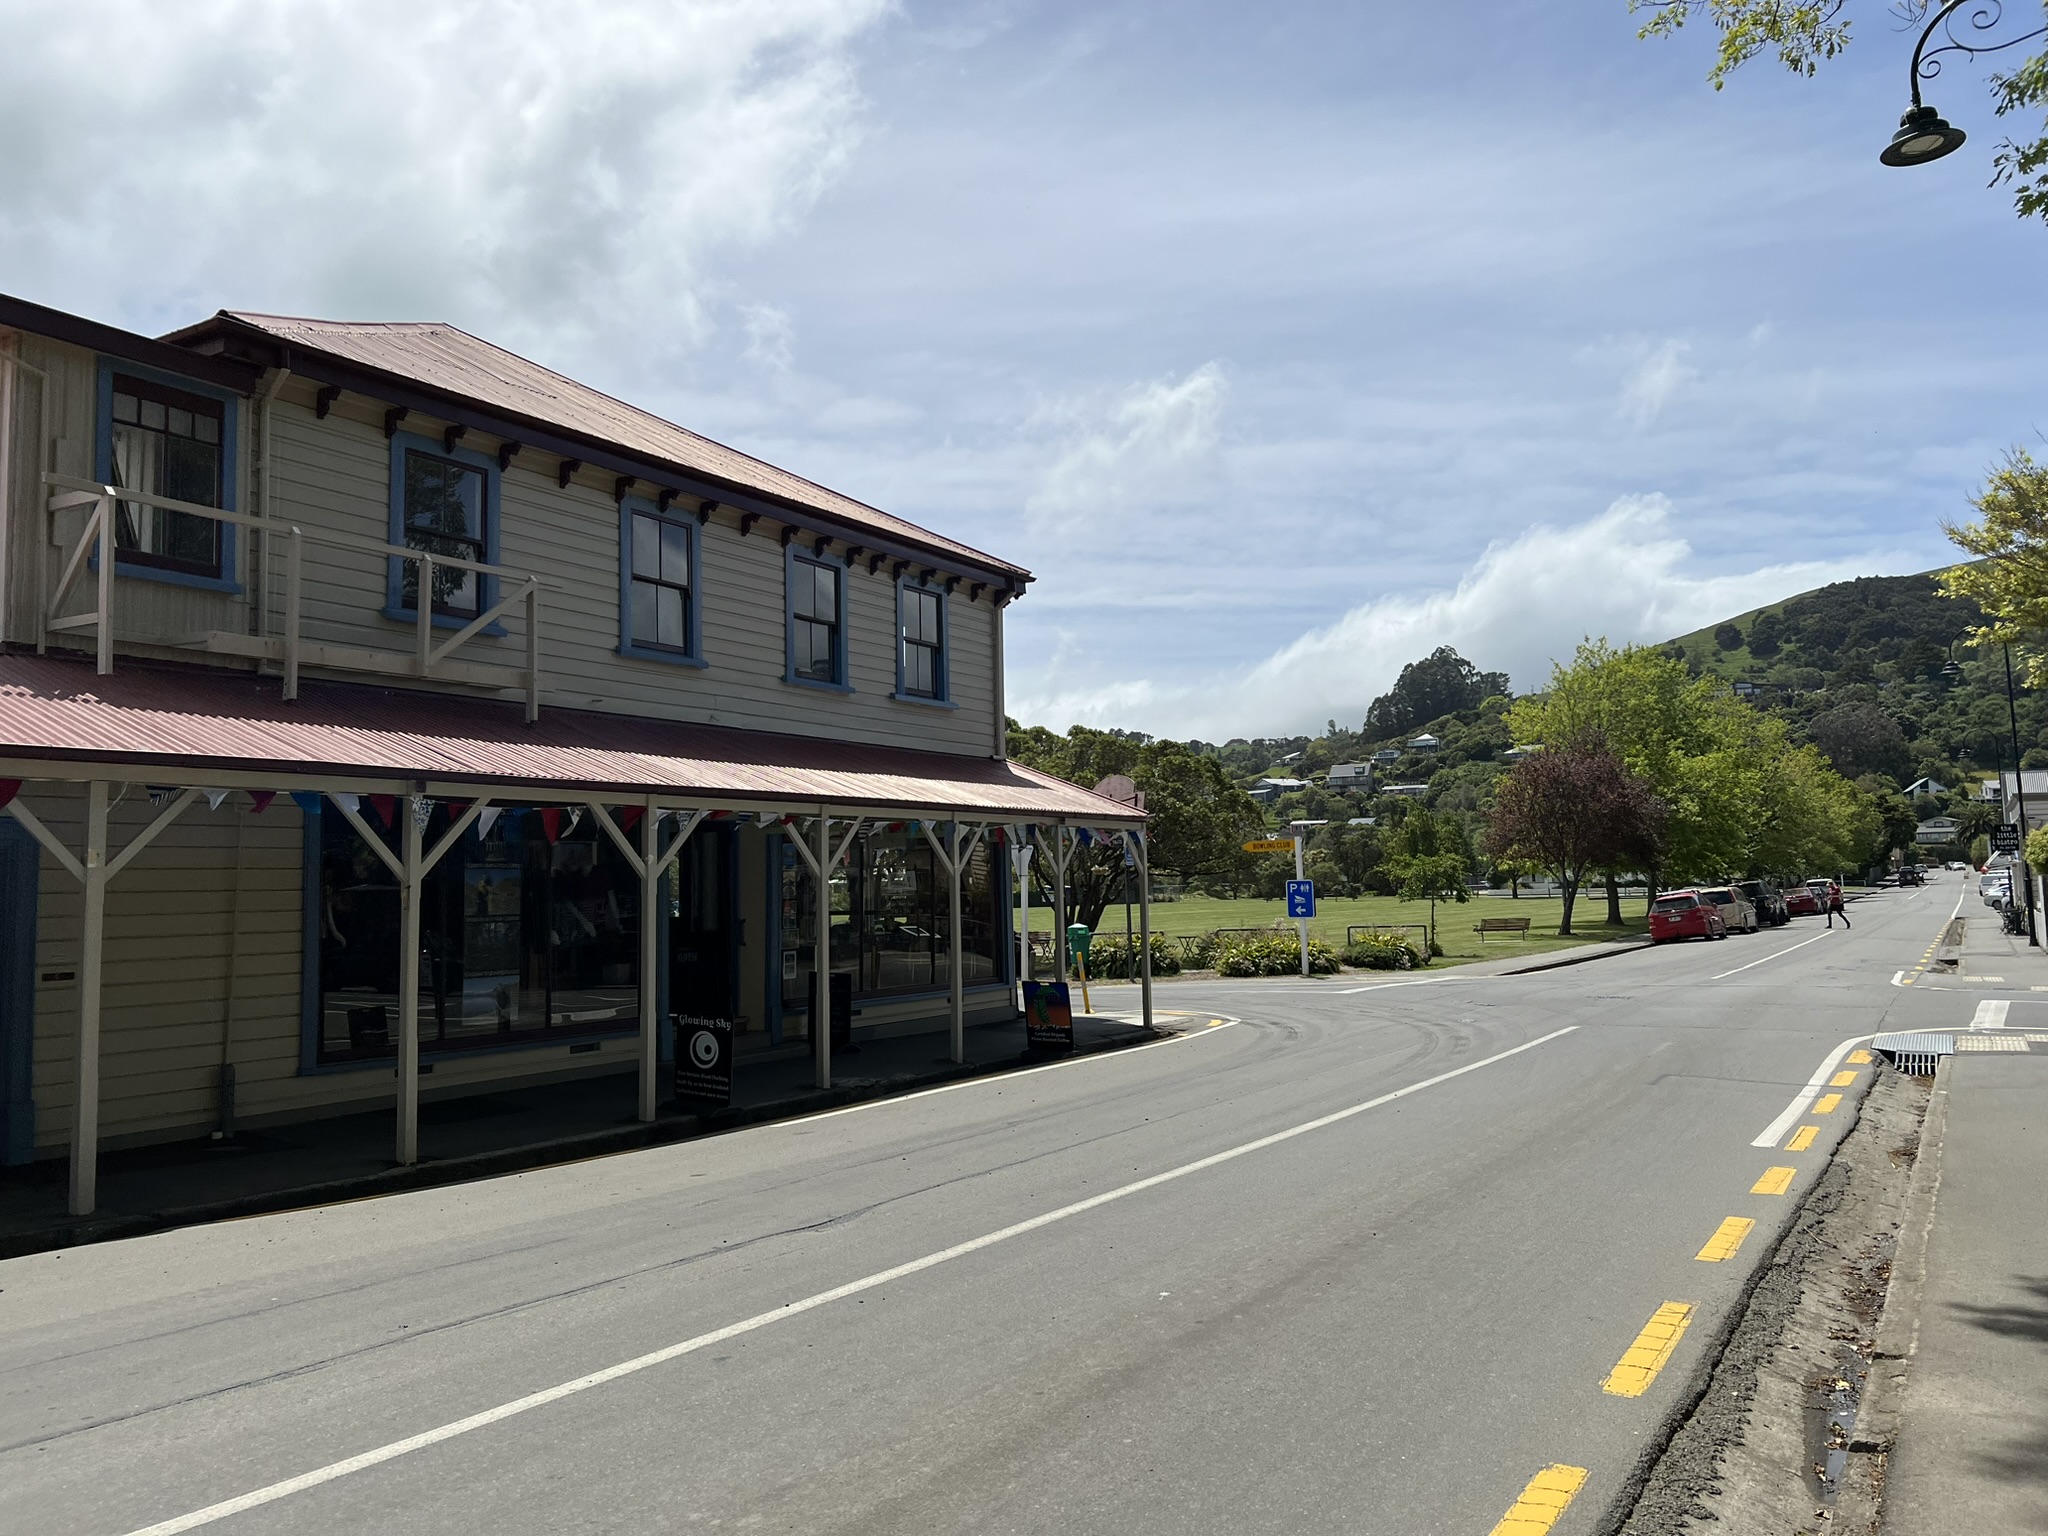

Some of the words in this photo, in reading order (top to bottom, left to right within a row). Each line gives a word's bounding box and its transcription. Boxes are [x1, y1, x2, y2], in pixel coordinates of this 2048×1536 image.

[1252, 842, 1275, 850] BOWLING
[1289, 883, 1298, 893] P
[679, 1014, 714, 1028] Glowing
[715, 1018, 732, 1031] Sky
